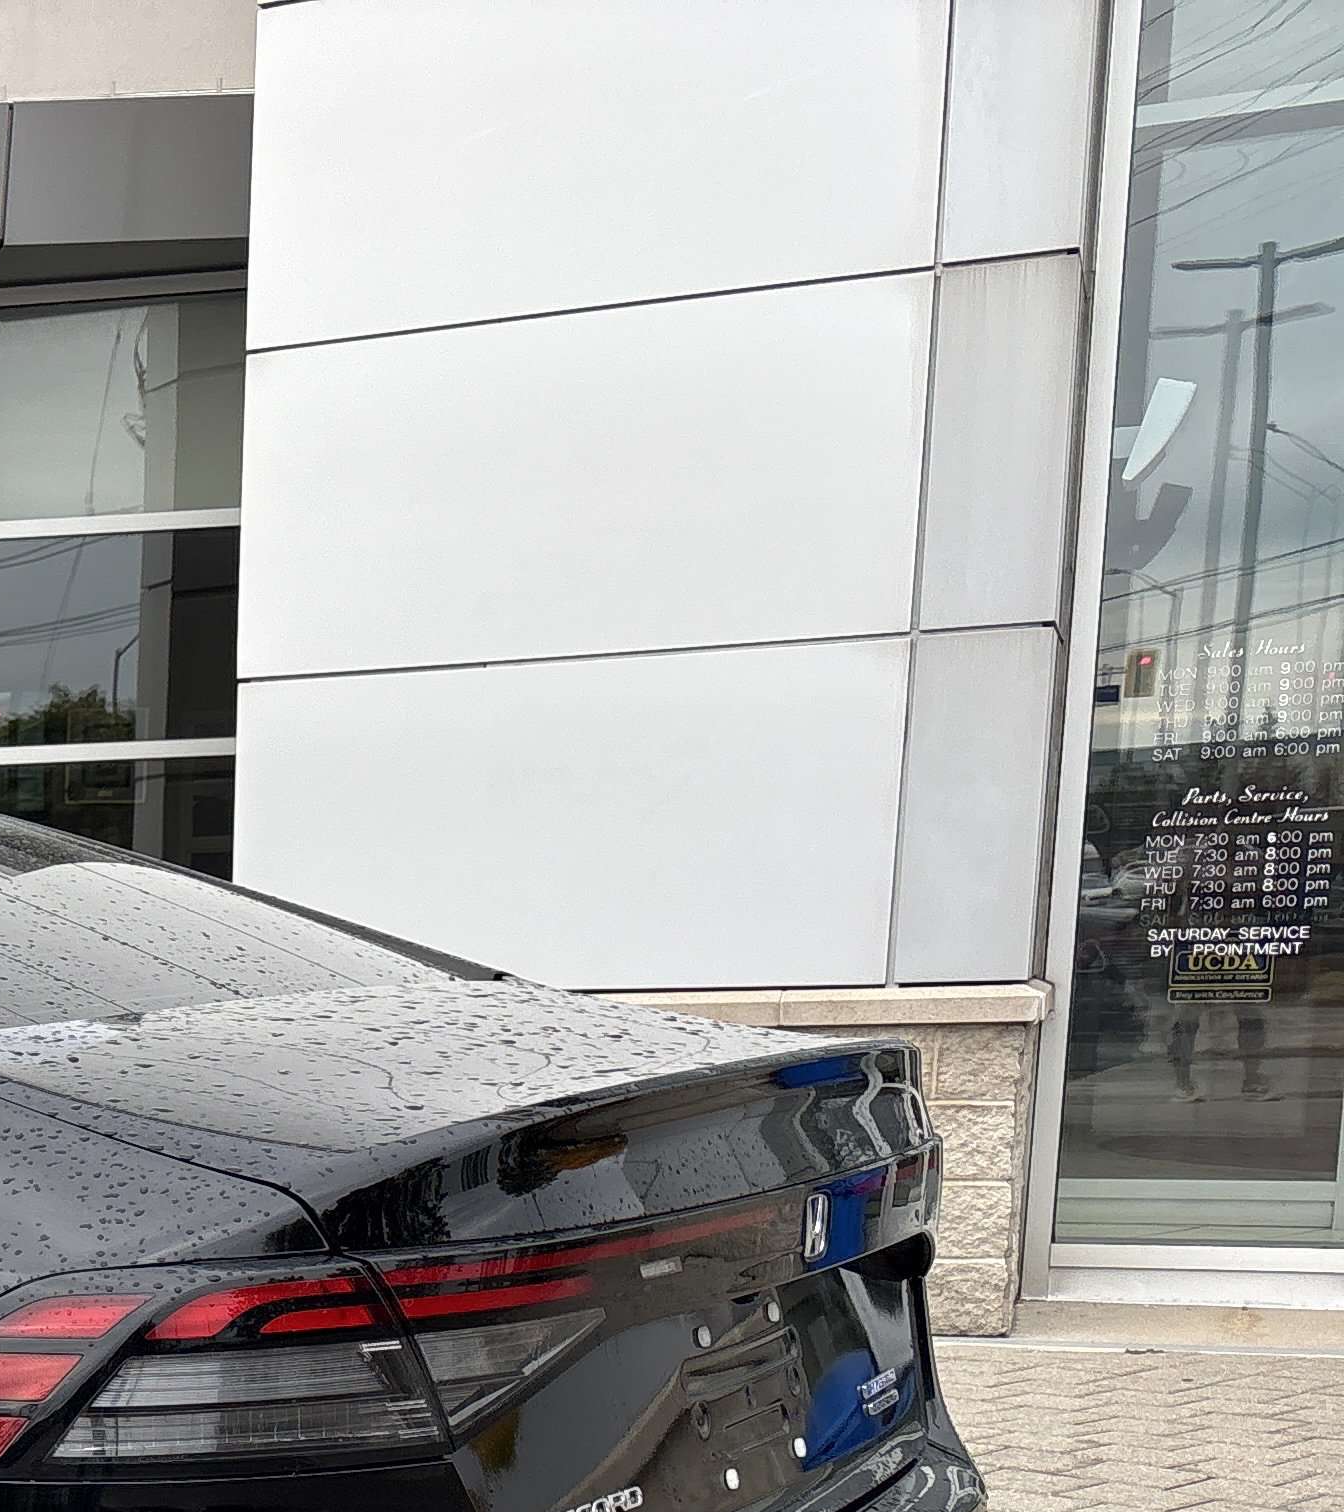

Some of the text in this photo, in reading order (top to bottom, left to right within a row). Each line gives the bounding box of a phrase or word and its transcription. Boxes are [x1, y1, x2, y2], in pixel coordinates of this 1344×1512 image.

[1199, 639, 1304, 659] Sales Hours
[1158, 667, 1198, 680] MON
[1159, 683, 1192, 696] TUE
[1156, 700, 1196, 713] WED
[1278, 693, 1313, 706] 9:00
[1320, 694, 1344, 706] pm
[1277, 709, 1312, 722] 9:00
[1318, 710, 1343, 722] pm
[1154, 726, 1342, 746] FRI 9:00 am 6:00 pm
[1152, 742, 1340, 762] SAT 9:00 am 6:00 pm
[1182, 784, 1309, 806] Parts, Service,
[1152, 806, 1329, 828] Collision Centre Hours
[1145, 830, 1334, 848] MON 7:30 am 6:00 pm
[1146, 846, 1332, 864] TUE 7:30 am 8:00 pm
[1144, 862, 1330, 879] WED 7:30 am 8:00 pm
[1144, 878, 1330, 895] THU 7:30 am 8:00 pm
[1140, 894, 1328, 911] FRI 7:30 am 6:00 pm
[1147, 925, 1311, 942] SATURDAY SERVICE
[1150, 941, 1304, 958] BY PPOINTMENT
[1187, 954, 1259, 970] UCDA
